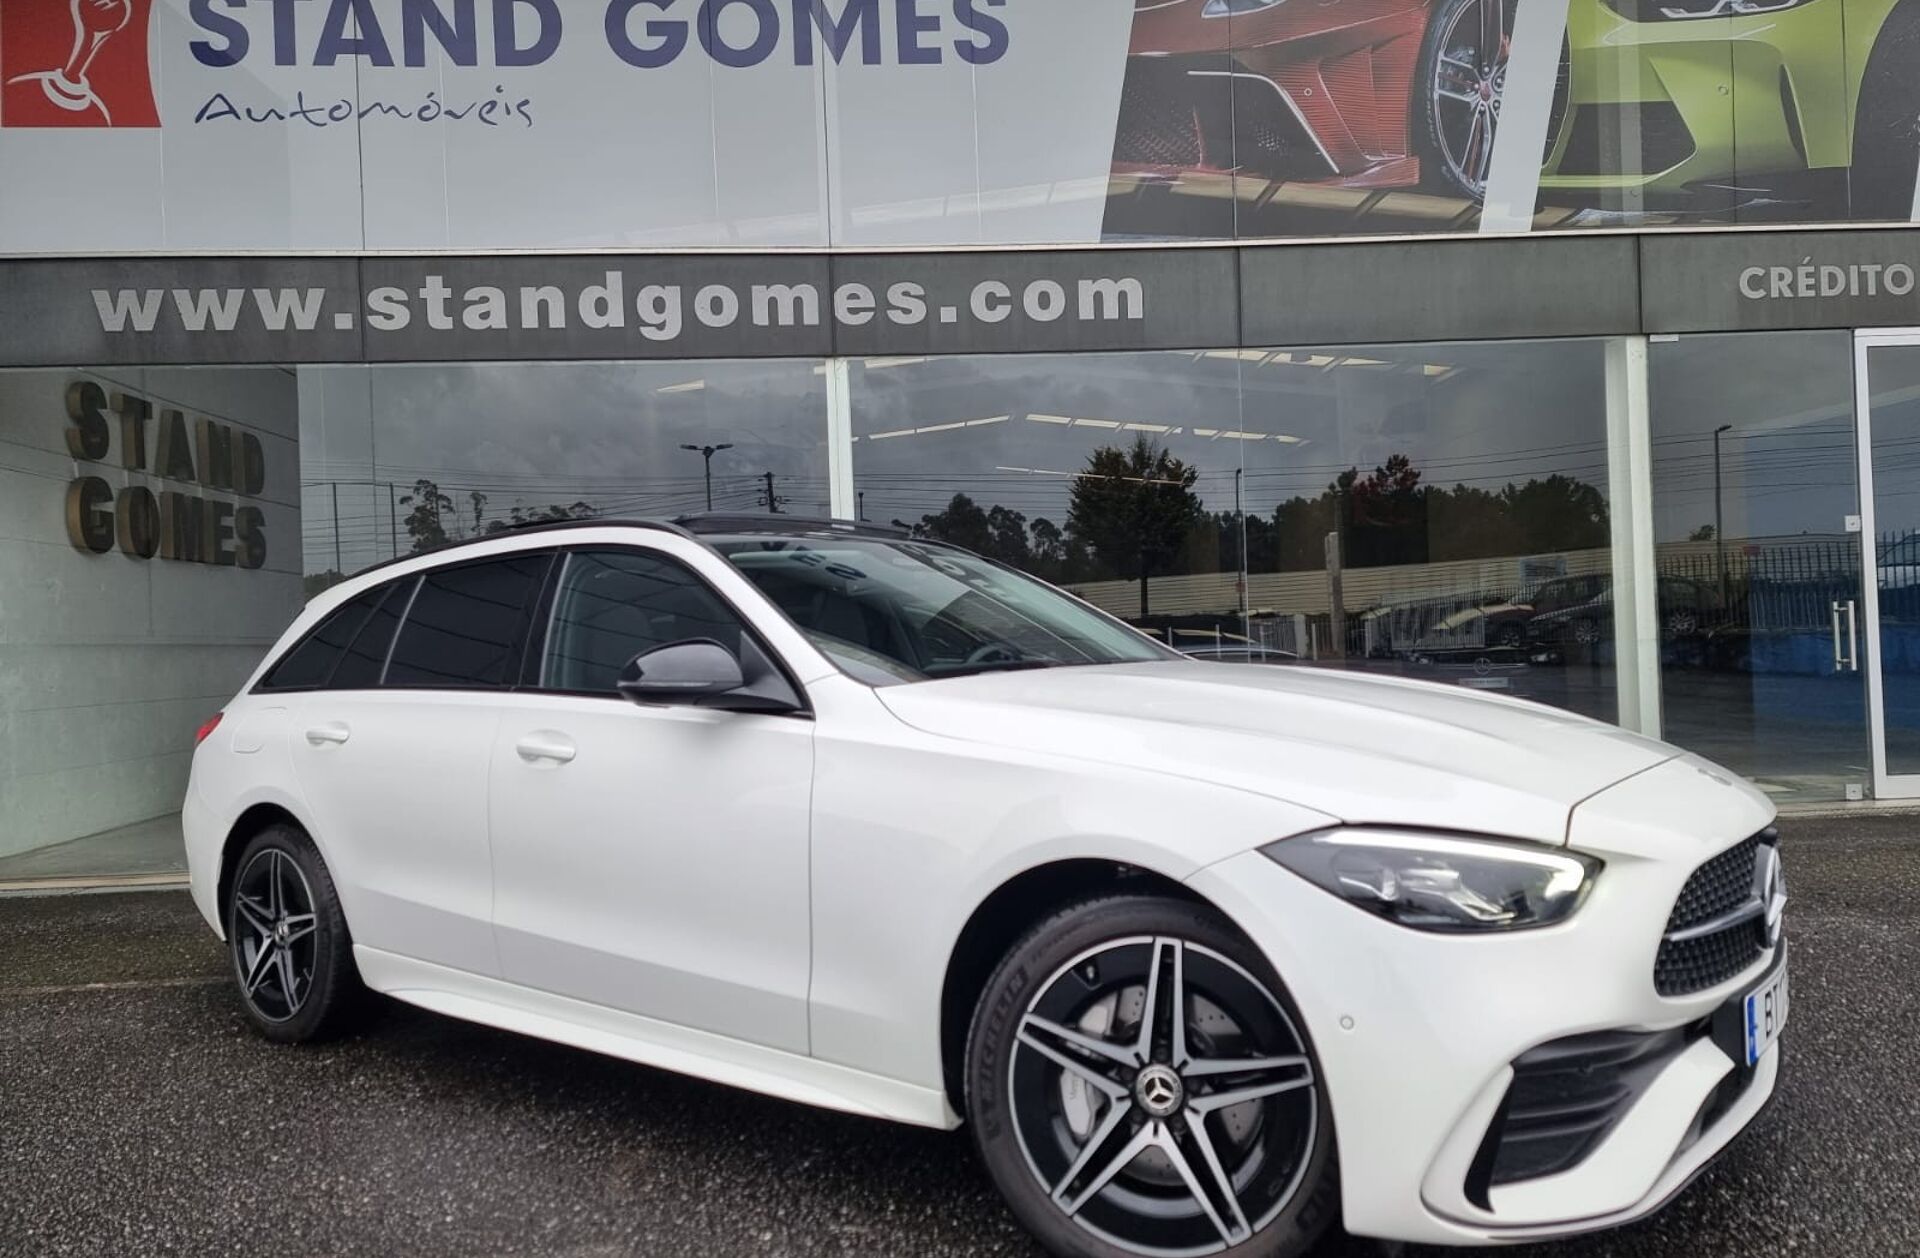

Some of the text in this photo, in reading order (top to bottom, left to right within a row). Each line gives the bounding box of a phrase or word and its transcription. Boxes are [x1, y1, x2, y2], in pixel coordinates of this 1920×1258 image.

[189, 0, 1010, 68] STAND GOMES
[194, 85, 532, 127] Automóveis
[91, 271, 1145, 341] www.standgomes.com
[1739, 256, 1915, 299] CRÉDITO
[66, 381, 265, 495] STAND
[66, 476, 267, 569] GOMES
